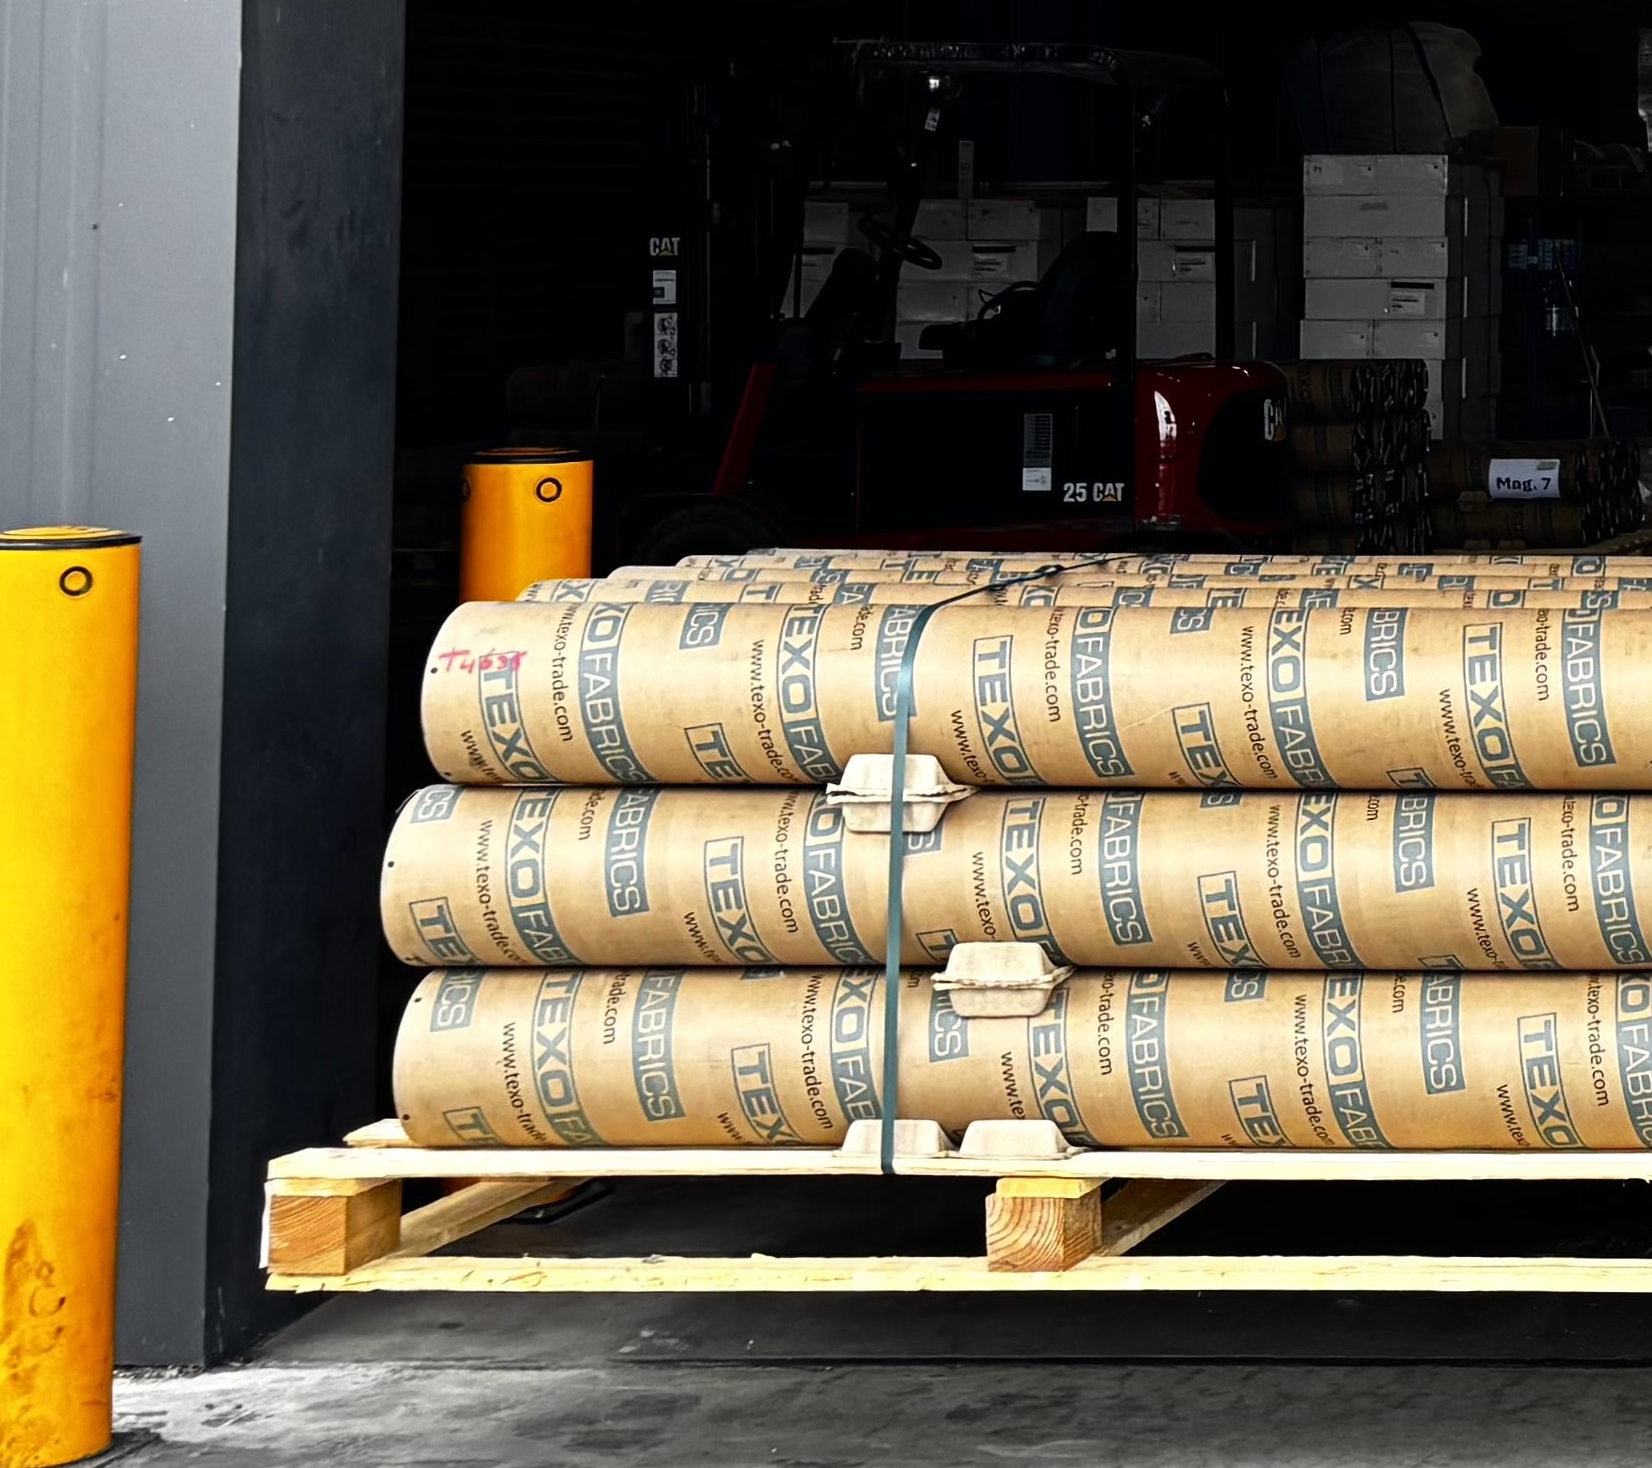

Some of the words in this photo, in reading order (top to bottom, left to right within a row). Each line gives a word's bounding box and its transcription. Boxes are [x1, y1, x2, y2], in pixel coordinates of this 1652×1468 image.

[650, 237, 681, 256] CAT
[1063, 482, 1087, 502] 25
[1093, 482, 1125, 503] CAT
[1541, 477, 1551, 490] 7
[976, 641, 1030, 783] TEXO
[1075, 634, 1120, 776] FABRICS
[1242, 626, 1277, 780] www.texo-trade.com
[1271, 609, 1302, 694] EXO
[1370, 609, 1399, 696] BRICS
[1467, 626, 1508, 762] TEXO
[1567, 621, 1606, 765] FABRICS
[483, 657, 551, 782] TEXO
[583, 650, 648, 782] FABRICS
[1181, 709, 1231, 786] TEX
[1276, 704, 1326, 786] FABR
[611, 789, 648, 912] ABRICS
[1005, 802, 1043, 930] TEXO
[1105, 797, 1146, 944] FABRICS
[1267, 805, 1300, 958] www.texo-trade.com
[1300, 794, 1334, 872] EXO
[1398, 795, 1430, 887] BRICS
[1497, 823, 1546, 957] TEXO
[1594, 827, 1641, 963] FABRICS
[709, 844, 770, 963] TEXO
[1203, 879, 1257, 966] TEX
[535, 972, 575, 1106] TEXO
[1130, 995, 1180, 1139] FABRICS
[1325, 975, 1358, 1077] EXO
[1424, 975, 1457, 1090] ABRICS
[1524, 1020, 1574, 1147] TEXO
[737, 1051, 794, 1143] TEX
